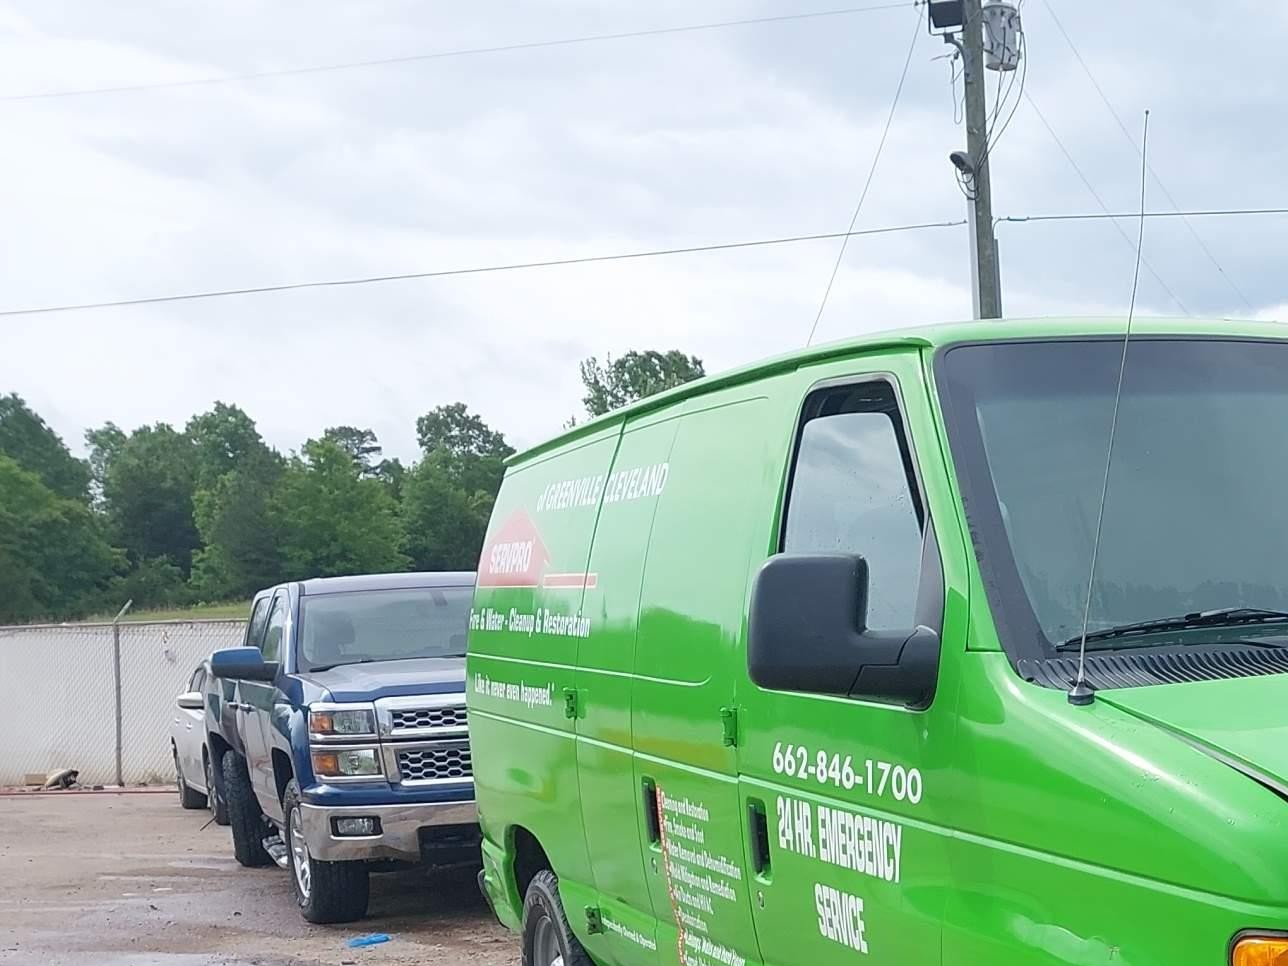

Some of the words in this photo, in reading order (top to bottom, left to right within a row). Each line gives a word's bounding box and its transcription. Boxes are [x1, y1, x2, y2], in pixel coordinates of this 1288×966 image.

[545, 474, 602, 511] GREENVILLE
[603, 462, 669, 505] CLEVELAND
[489, 541, 532, 574] SERVPRO
[469, 608, 480, 630] Fire
[486, 608, 504, 631] Water
[508, 608, 535, 638] Cleanup
[535, 608, 542, 633] &
[543, 608, 591, 638] Restoration
[474, 672, 485, 694] Like
[490, 680, 506, 698] never
[506, 683, 520, 701] even
[772, 742, 923, 804] 662-846-1700
[776, 795, 794, 851] 24
[794, 799, 816, 859] HR.
[817, 805, 902, 883] EMERGENCY
[814, 883, 869, 954] SERVICE
